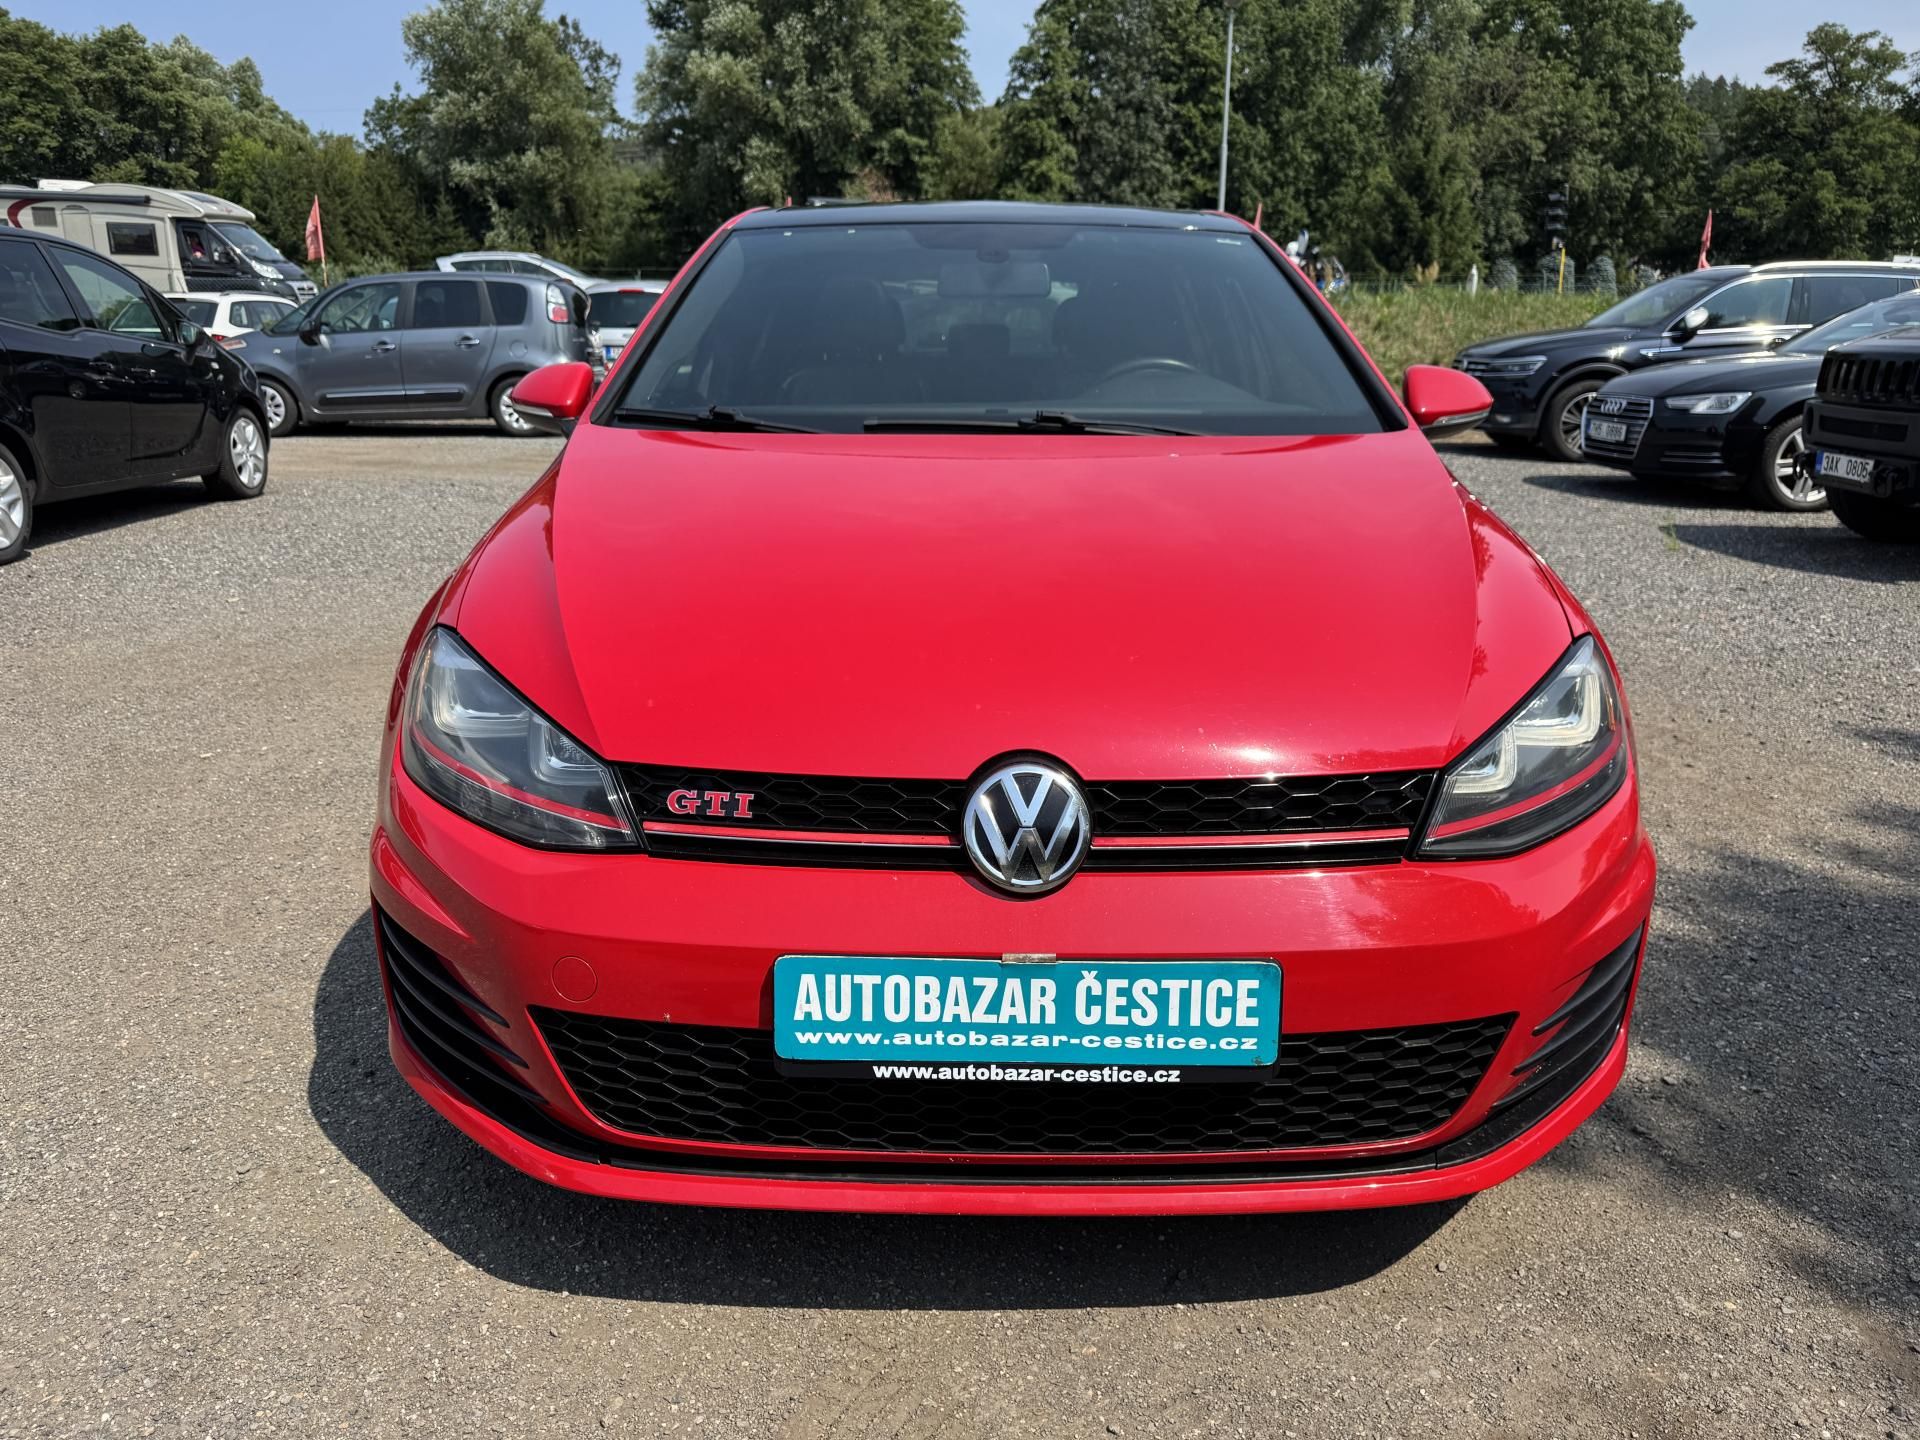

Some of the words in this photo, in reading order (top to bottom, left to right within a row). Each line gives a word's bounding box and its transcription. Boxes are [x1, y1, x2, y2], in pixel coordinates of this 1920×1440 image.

[1823, 455, 1841, 473] 3AK
[1846, 459, 1869, 478] 0805
[666, 789, 754, 819] GTI
[793, 973, 1057, 1025] AUTOBAZAR
[1075, 970, 1260, 1027] ČESTICE
[794, 1030, 1258, 1050] www.autobazar-cestice.cz
[872, 1064, 1181, 1083] www.autobazar-cestice.cz
